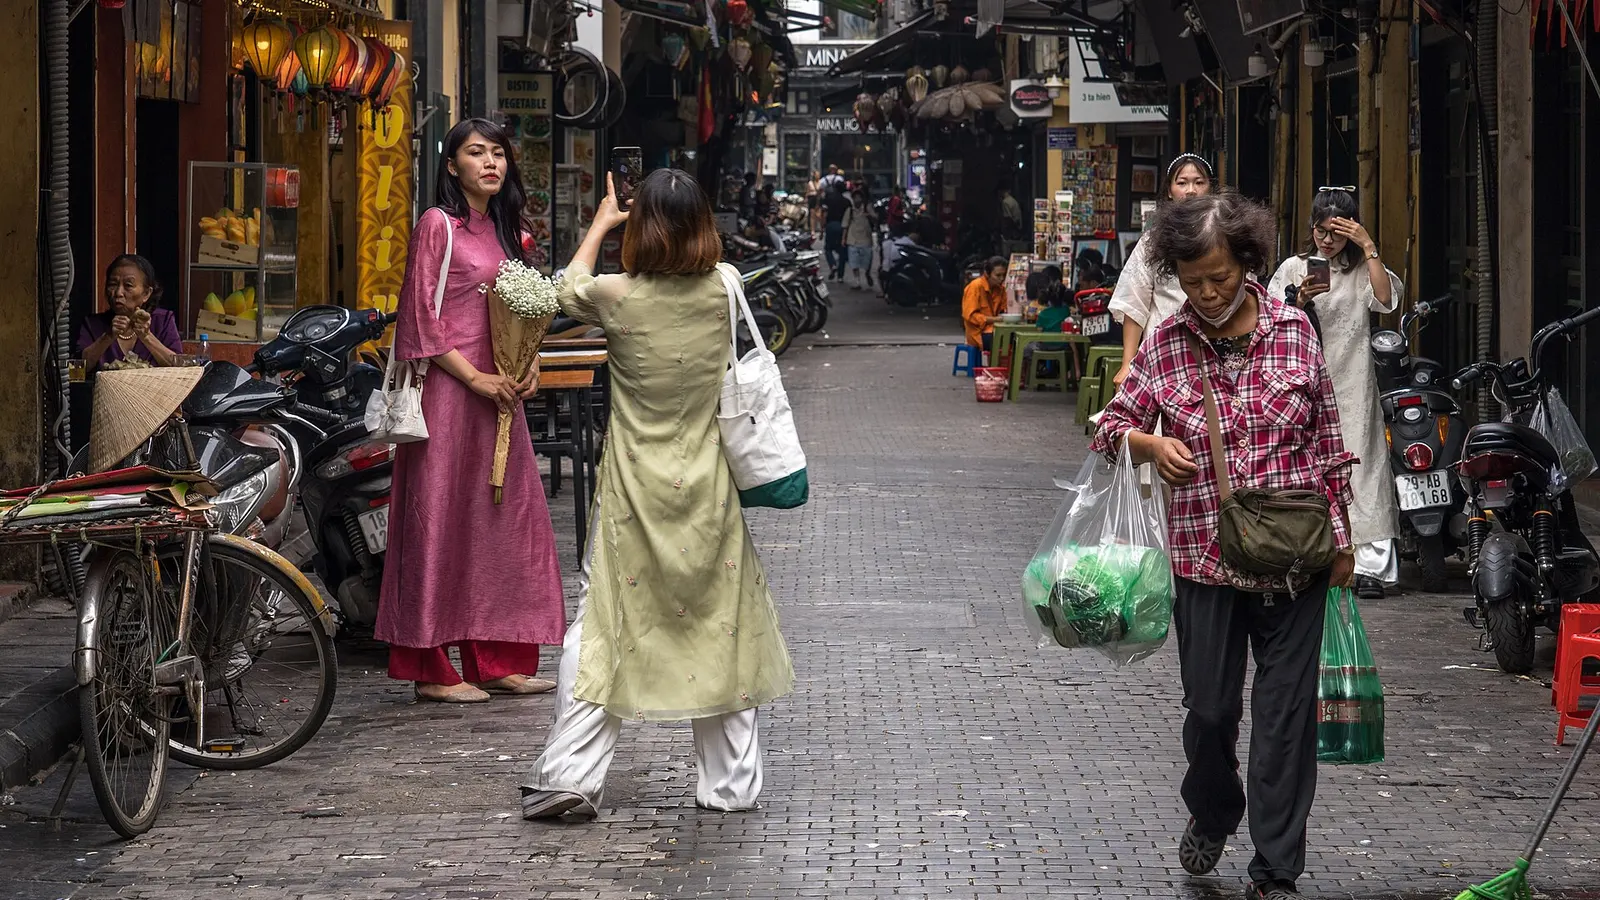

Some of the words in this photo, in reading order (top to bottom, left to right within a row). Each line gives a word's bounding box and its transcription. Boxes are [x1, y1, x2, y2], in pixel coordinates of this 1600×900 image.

[806, 47, 848, 67] MINA
[507, 80, 539, 92] BISTRO
[498, 97, 547, 110] VEGETABLE
[1082, 92, 1087, 102] 3
[1088, 93, 1095, 102] ta
[816, 118, 842, 131] MINA
[1404, 473, 1441, 492] 29-AB
[1402, 488, 1448, 508] 181.68
[368, 511, 387, 530] 18
